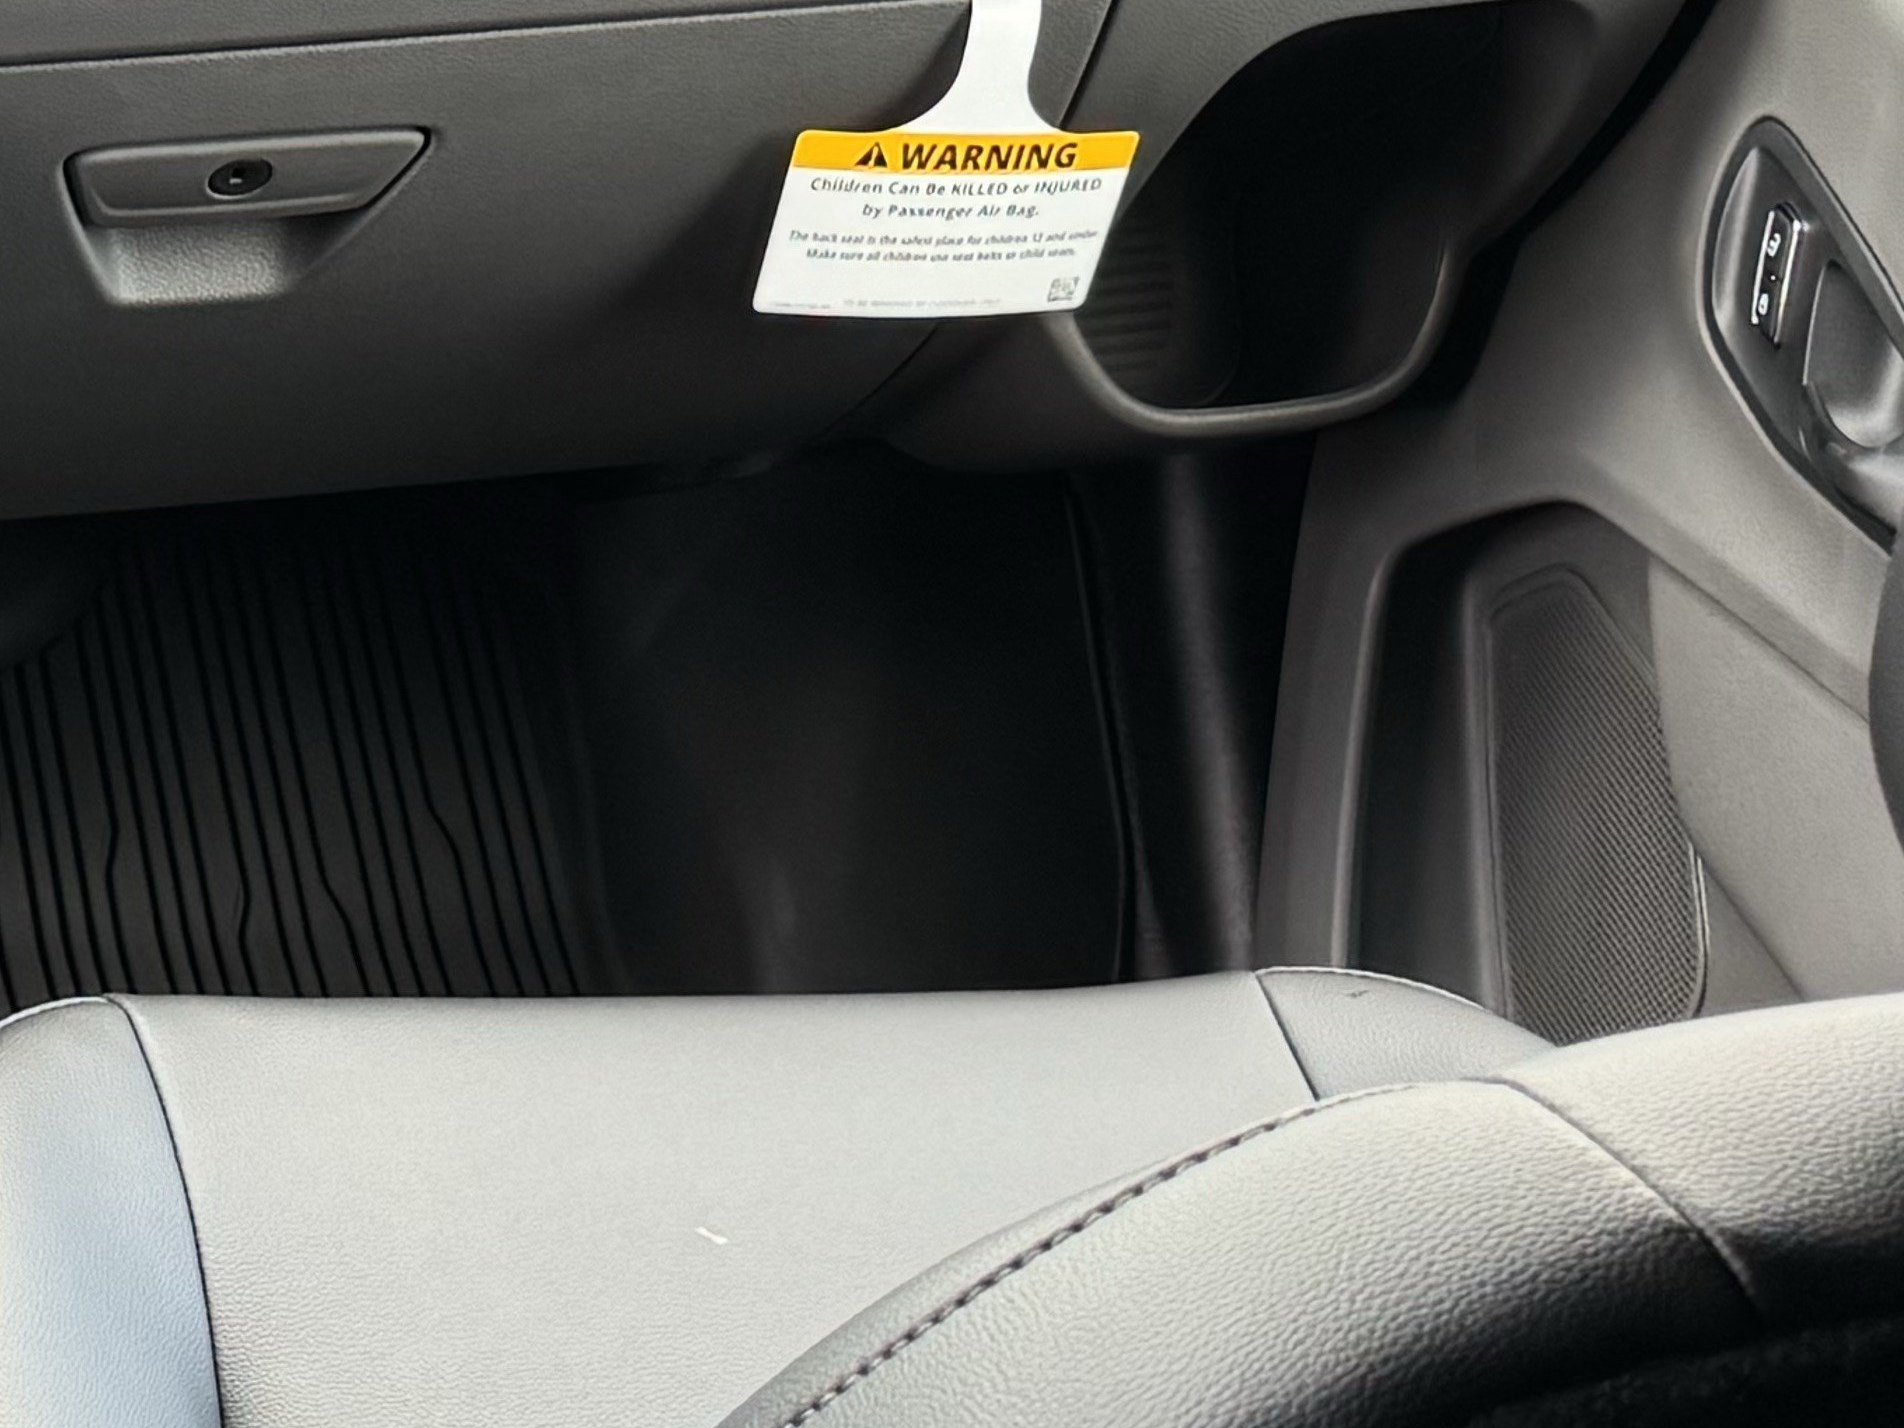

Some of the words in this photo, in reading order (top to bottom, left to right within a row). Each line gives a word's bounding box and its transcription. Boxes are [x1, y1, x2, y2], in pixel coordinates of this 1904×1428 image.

[901, 142, 1078, 171] WARNING
[810, 177, 883, 194] Children
[888, 181, 920, 195] Can
[925, 183, 946, 196] Be
[951, 182, 1008, 196] KILLED
[1012, 184, 1030, 195] or
[1034, 177, 1103, 195] INJURED
[862, 203, 883, 219] by
[887, 203, 973, 221] Passenger
[977, 203, 1001, 217] Air
[1005, 204, 1039, 219] Bag.
